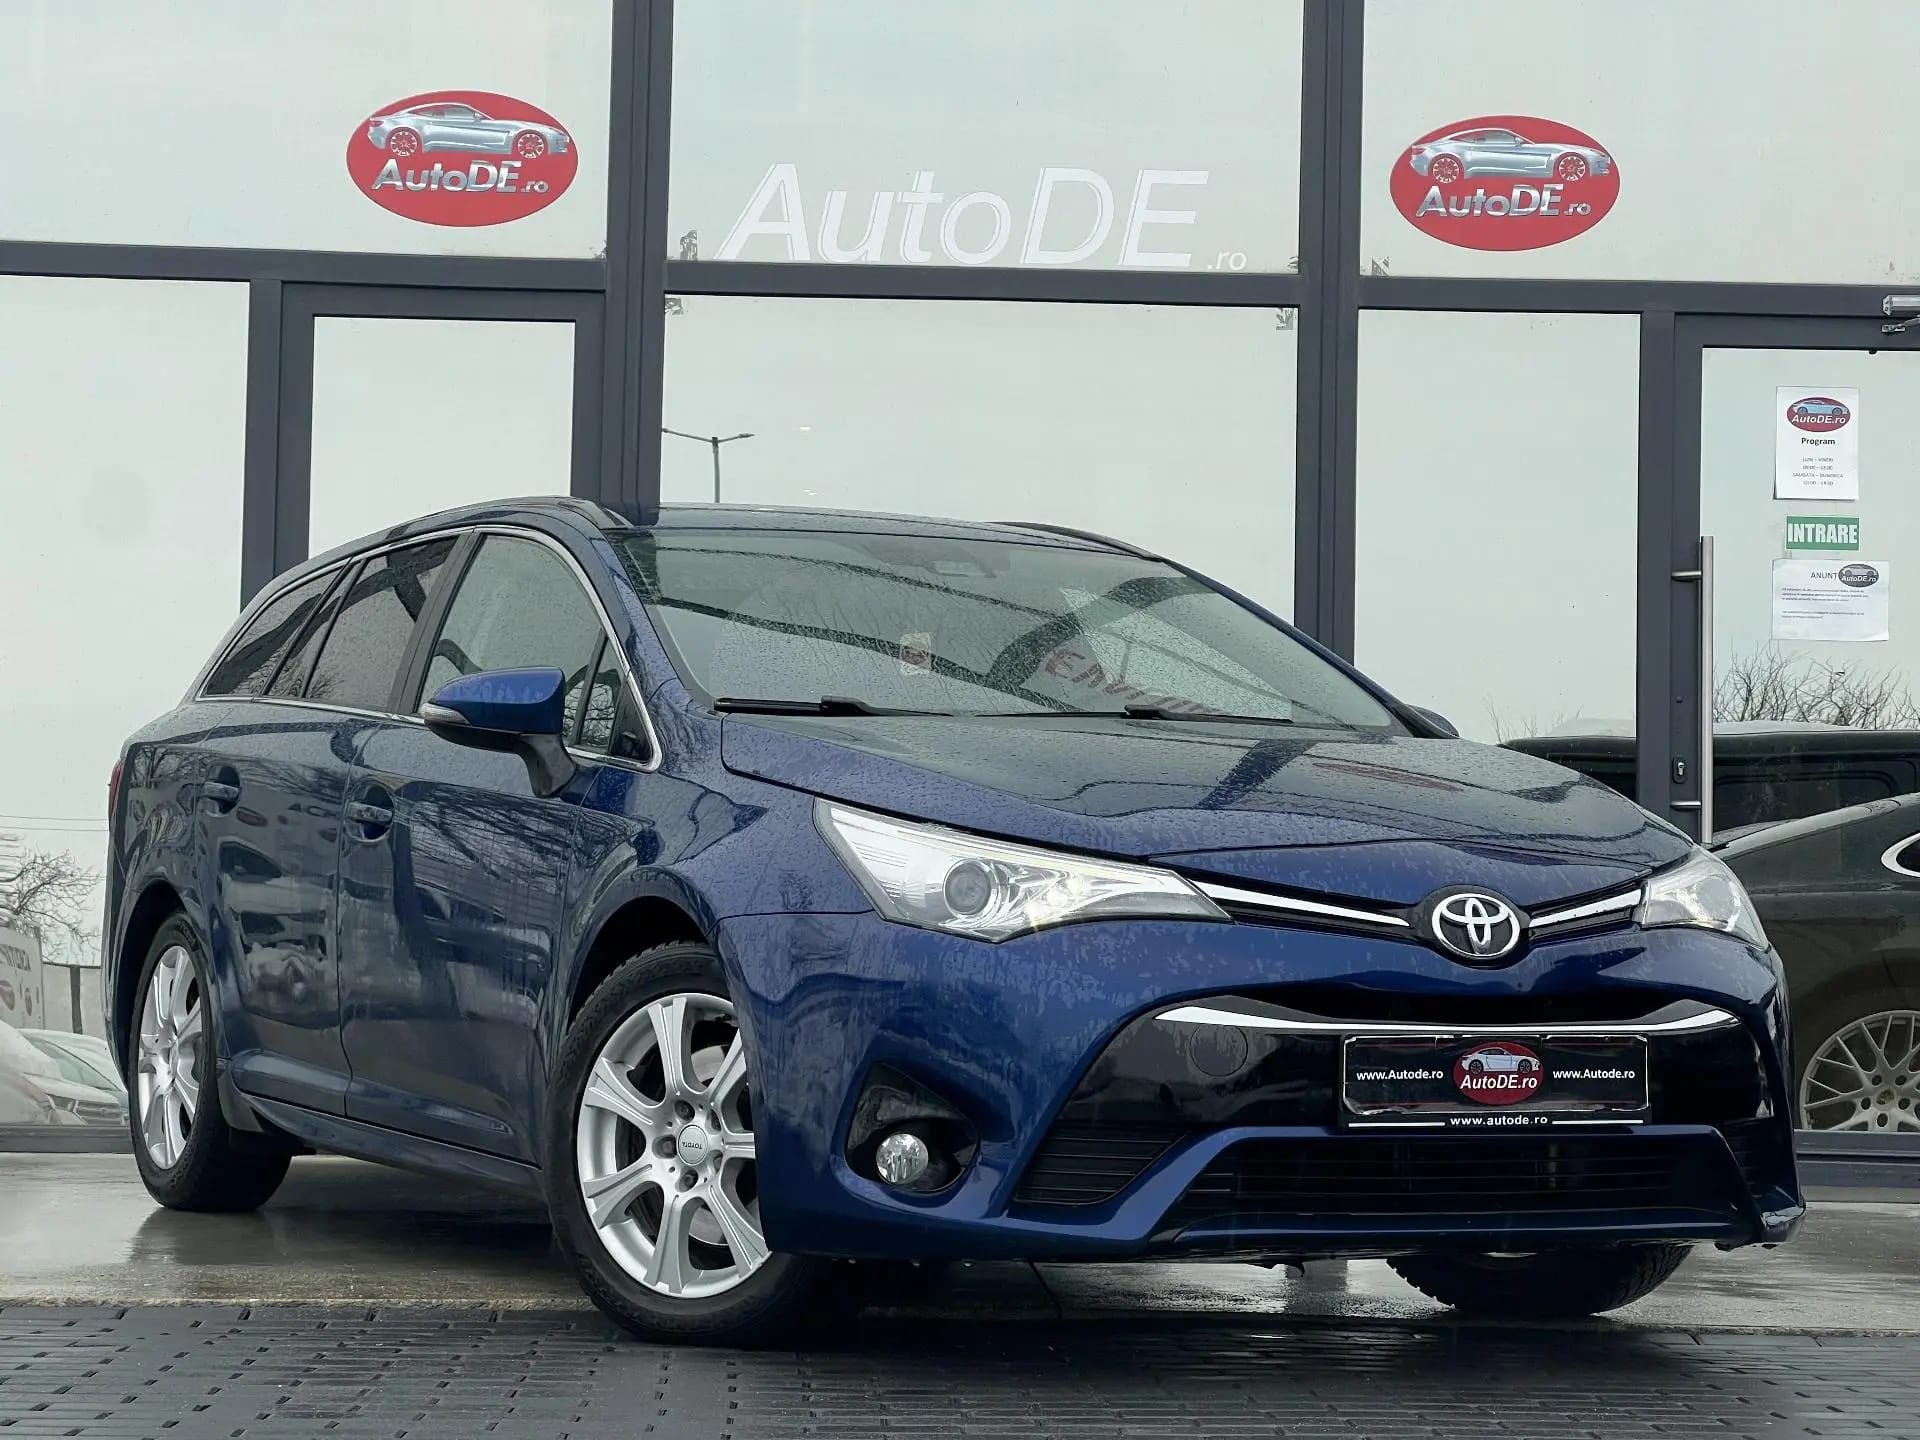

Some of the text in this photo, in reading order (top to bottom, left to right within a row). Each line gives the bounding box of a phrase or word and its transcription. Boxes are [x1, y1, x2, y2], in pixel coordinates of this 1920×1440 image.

[1791, 414, 1846, 424] AutoDE.ro
[1801, 437, 1836, 446] Program
[1787, 523, 1858, 544] INTRARE
[1356, 1068, 1444, 1081] www.Autode.ro
[1552, 1067, 1636, 1080] www.Autode.ro
[1459, 1074, 1538, 1090] AutoDE.ro
[1449, 1114, 1549, 1127] www.autode.ro
